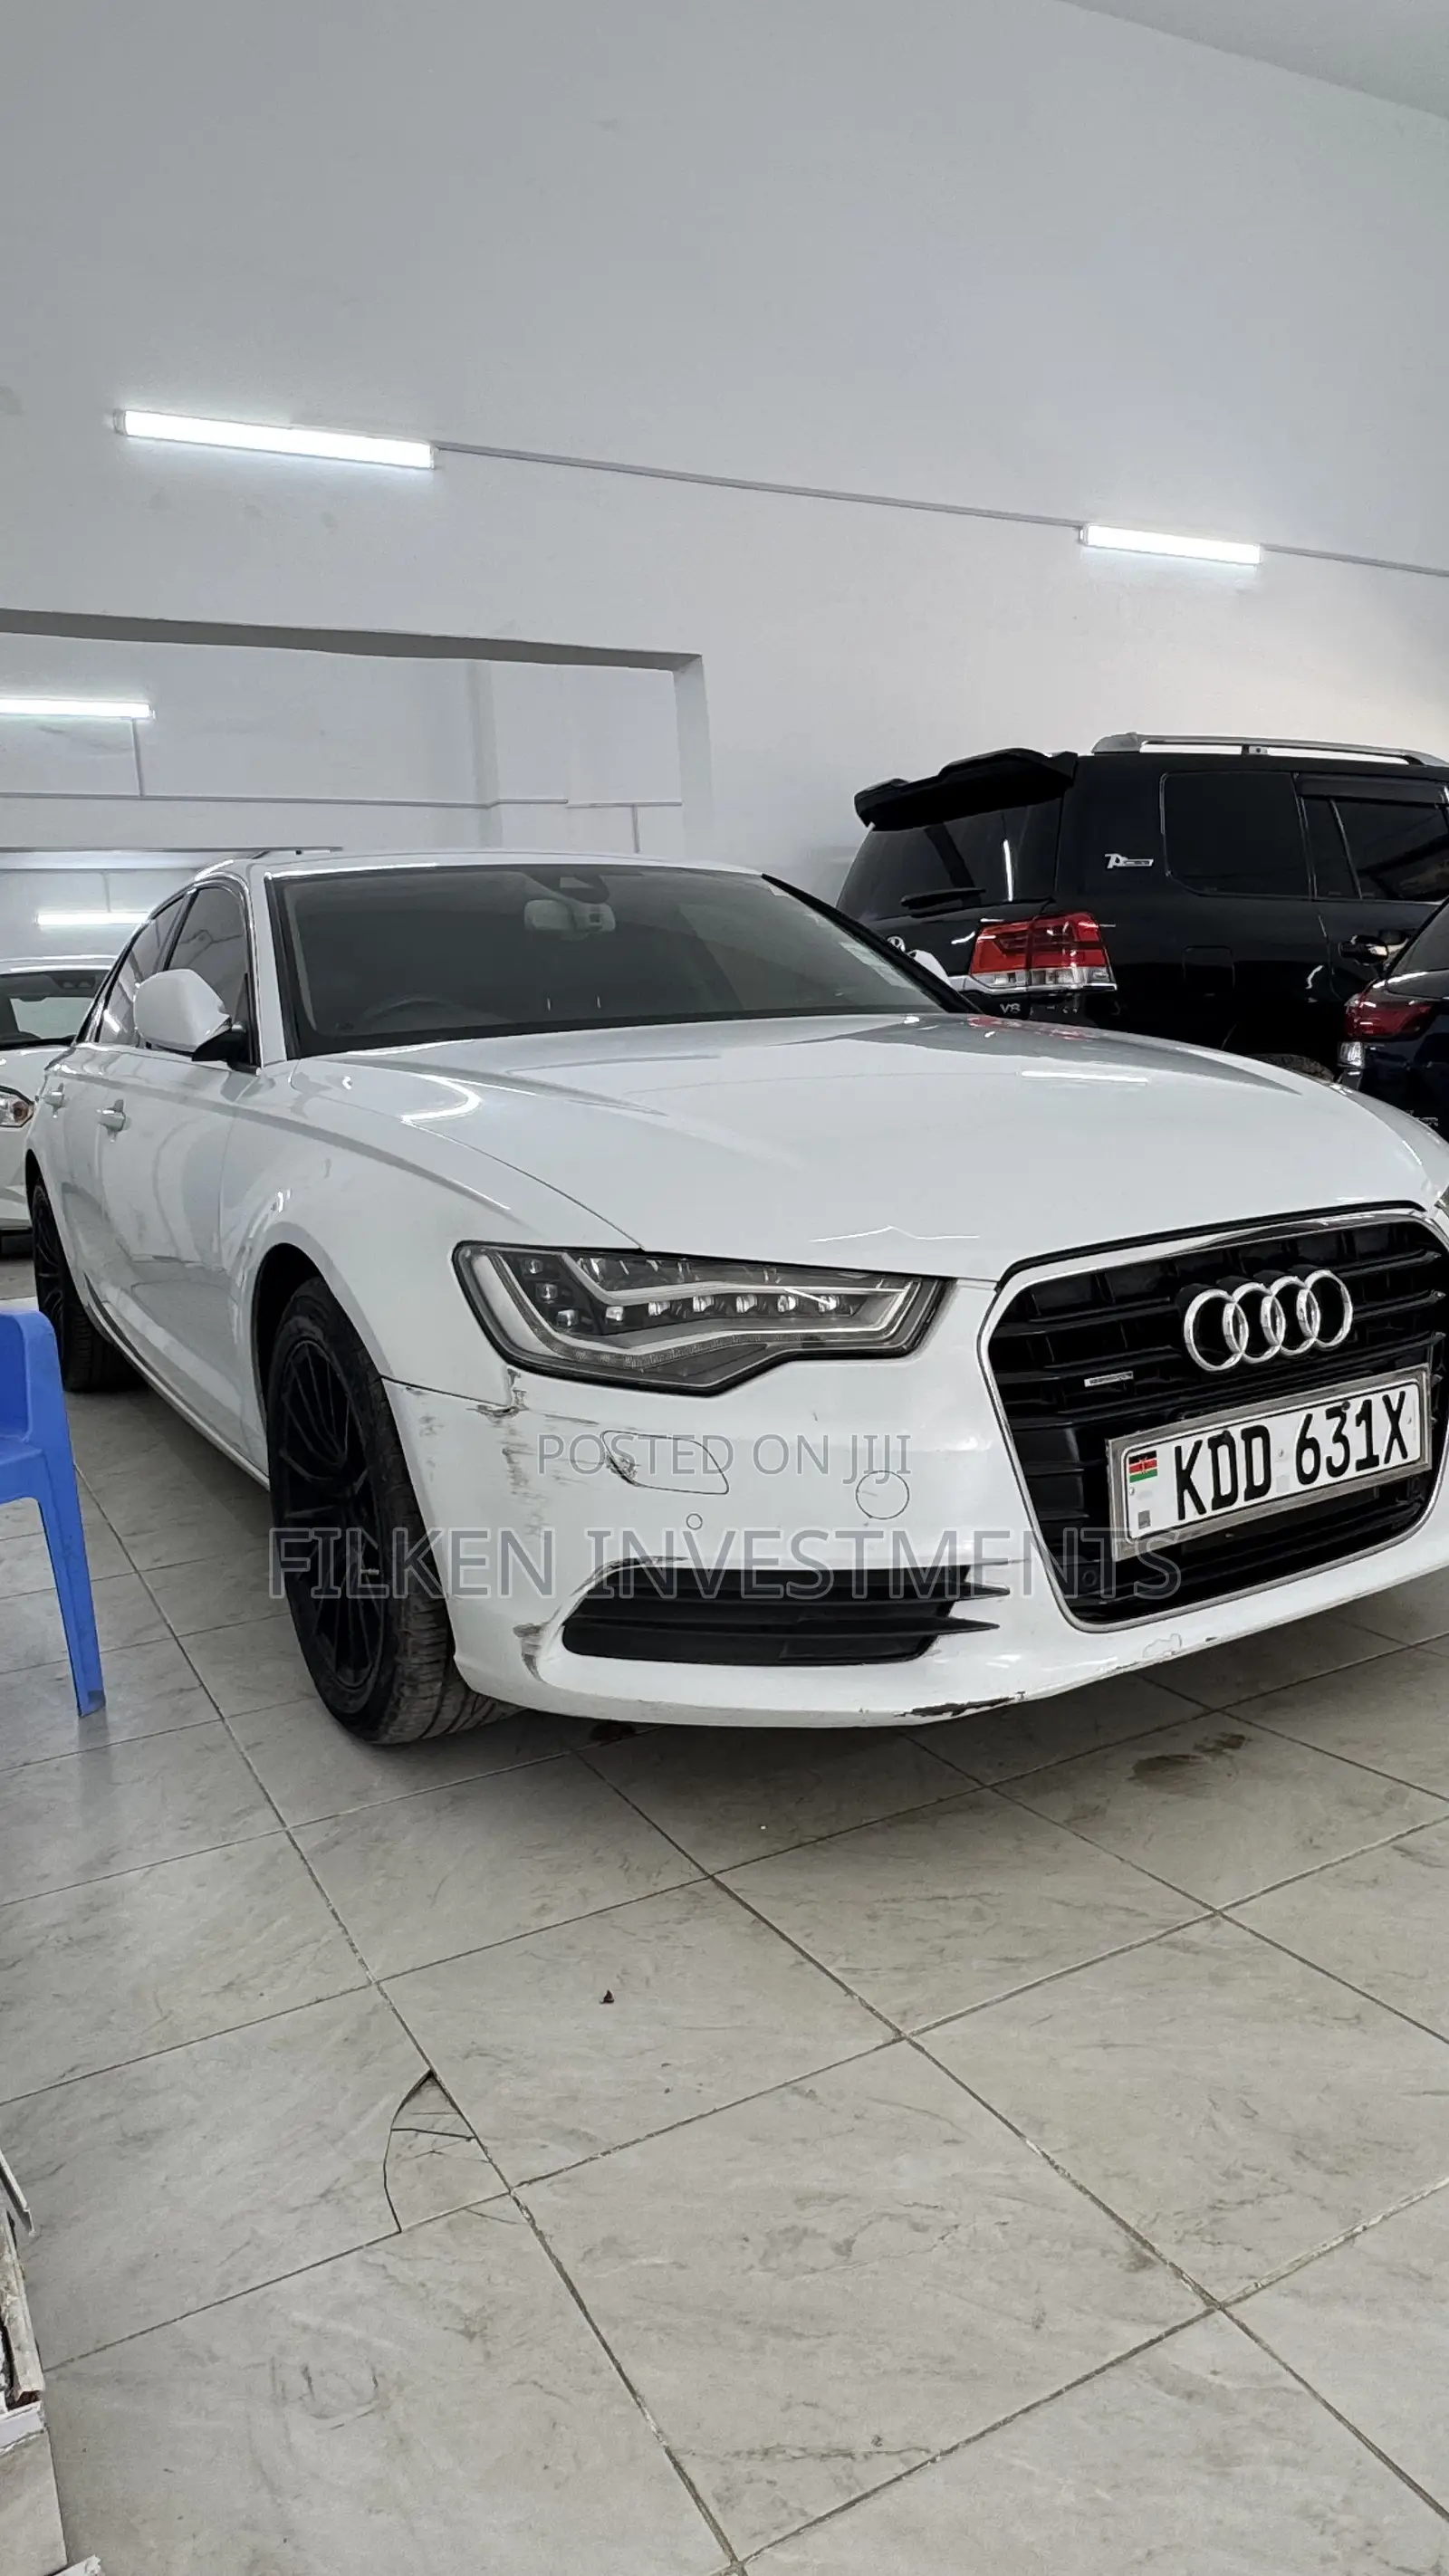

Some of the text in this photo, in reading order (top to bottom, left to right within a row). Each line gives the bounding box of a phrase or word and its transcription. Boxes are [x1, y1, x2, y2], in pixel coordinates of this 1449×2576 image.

[999, 1002, 1022, 1014] V8
[1175, 1391, 1409, 1521] KDD 631X
